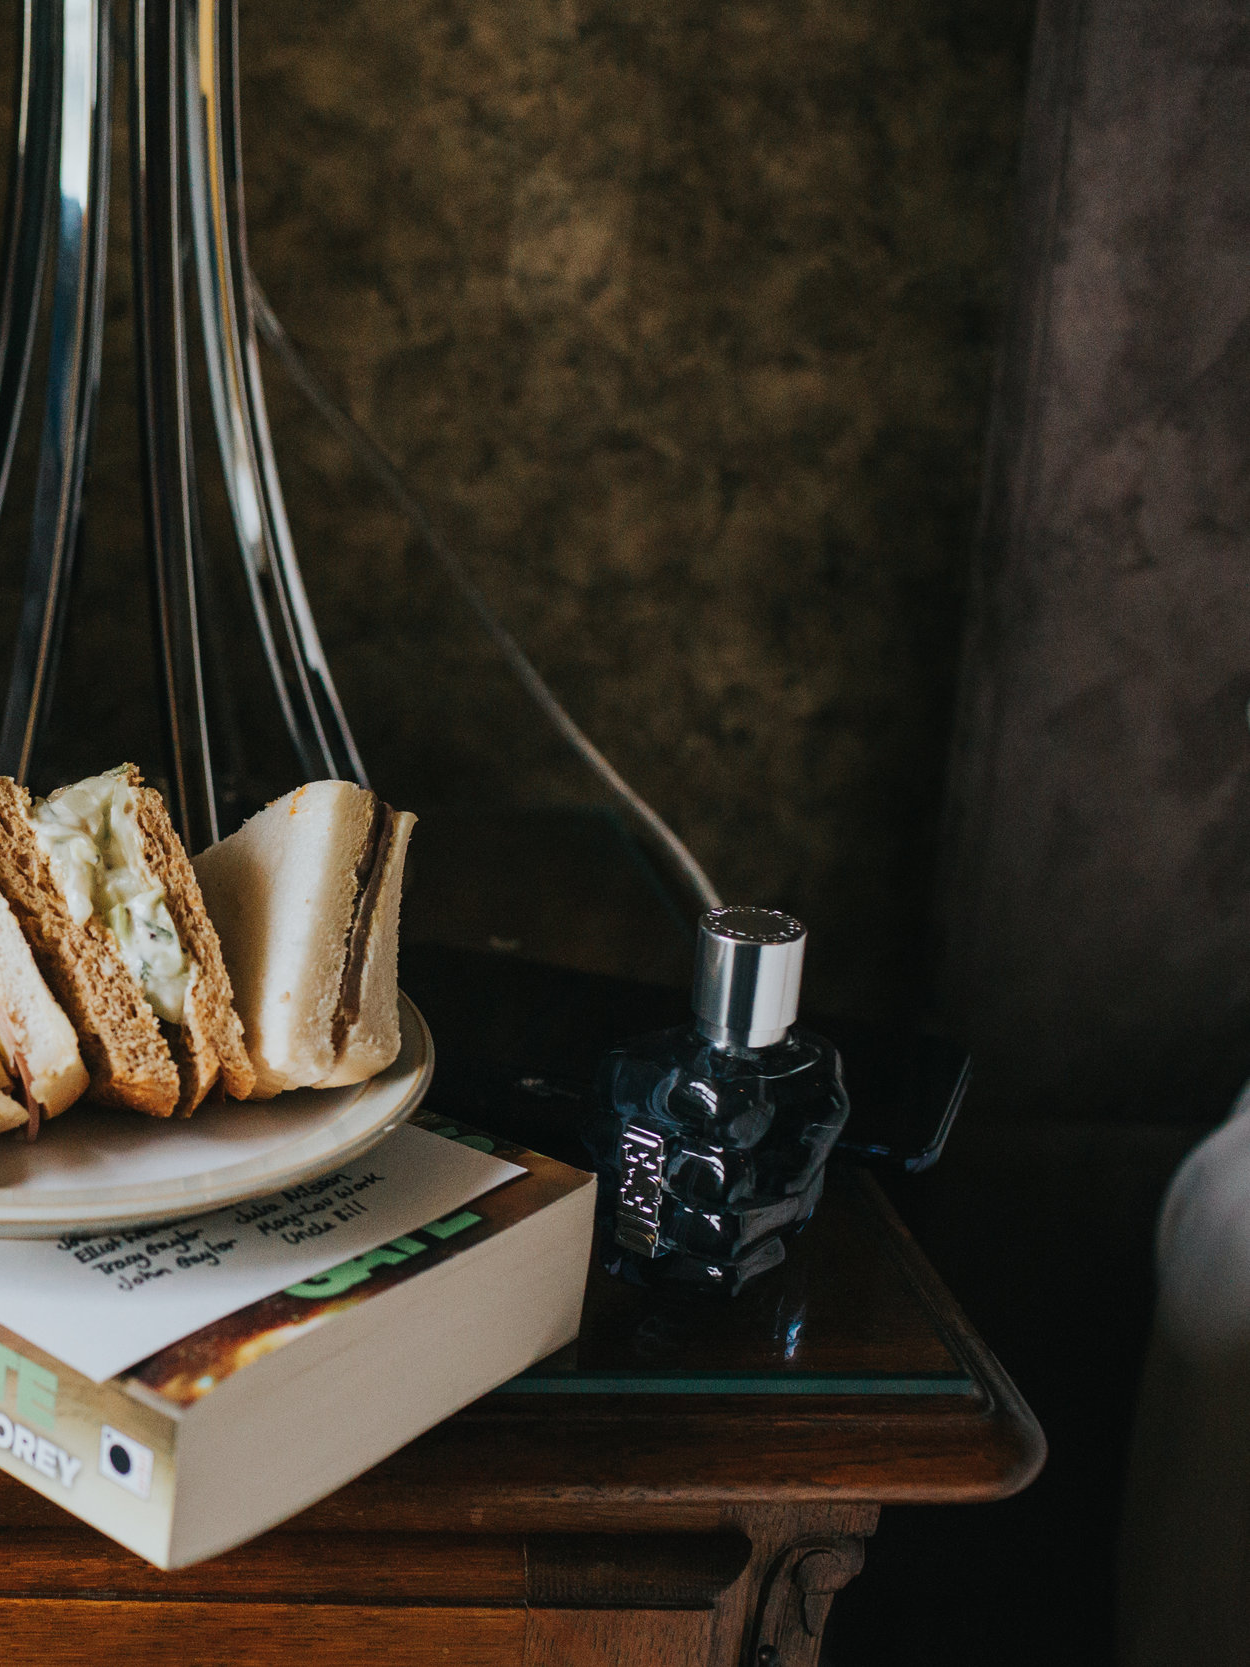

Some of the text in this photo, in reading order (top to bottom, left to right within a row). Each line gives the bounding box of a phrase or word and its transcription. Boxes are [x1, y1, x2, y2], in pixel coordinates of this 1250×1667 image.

[281, 1200, 369, 1245] Uncle Bill
[118, 1267, 173, 1292] John
